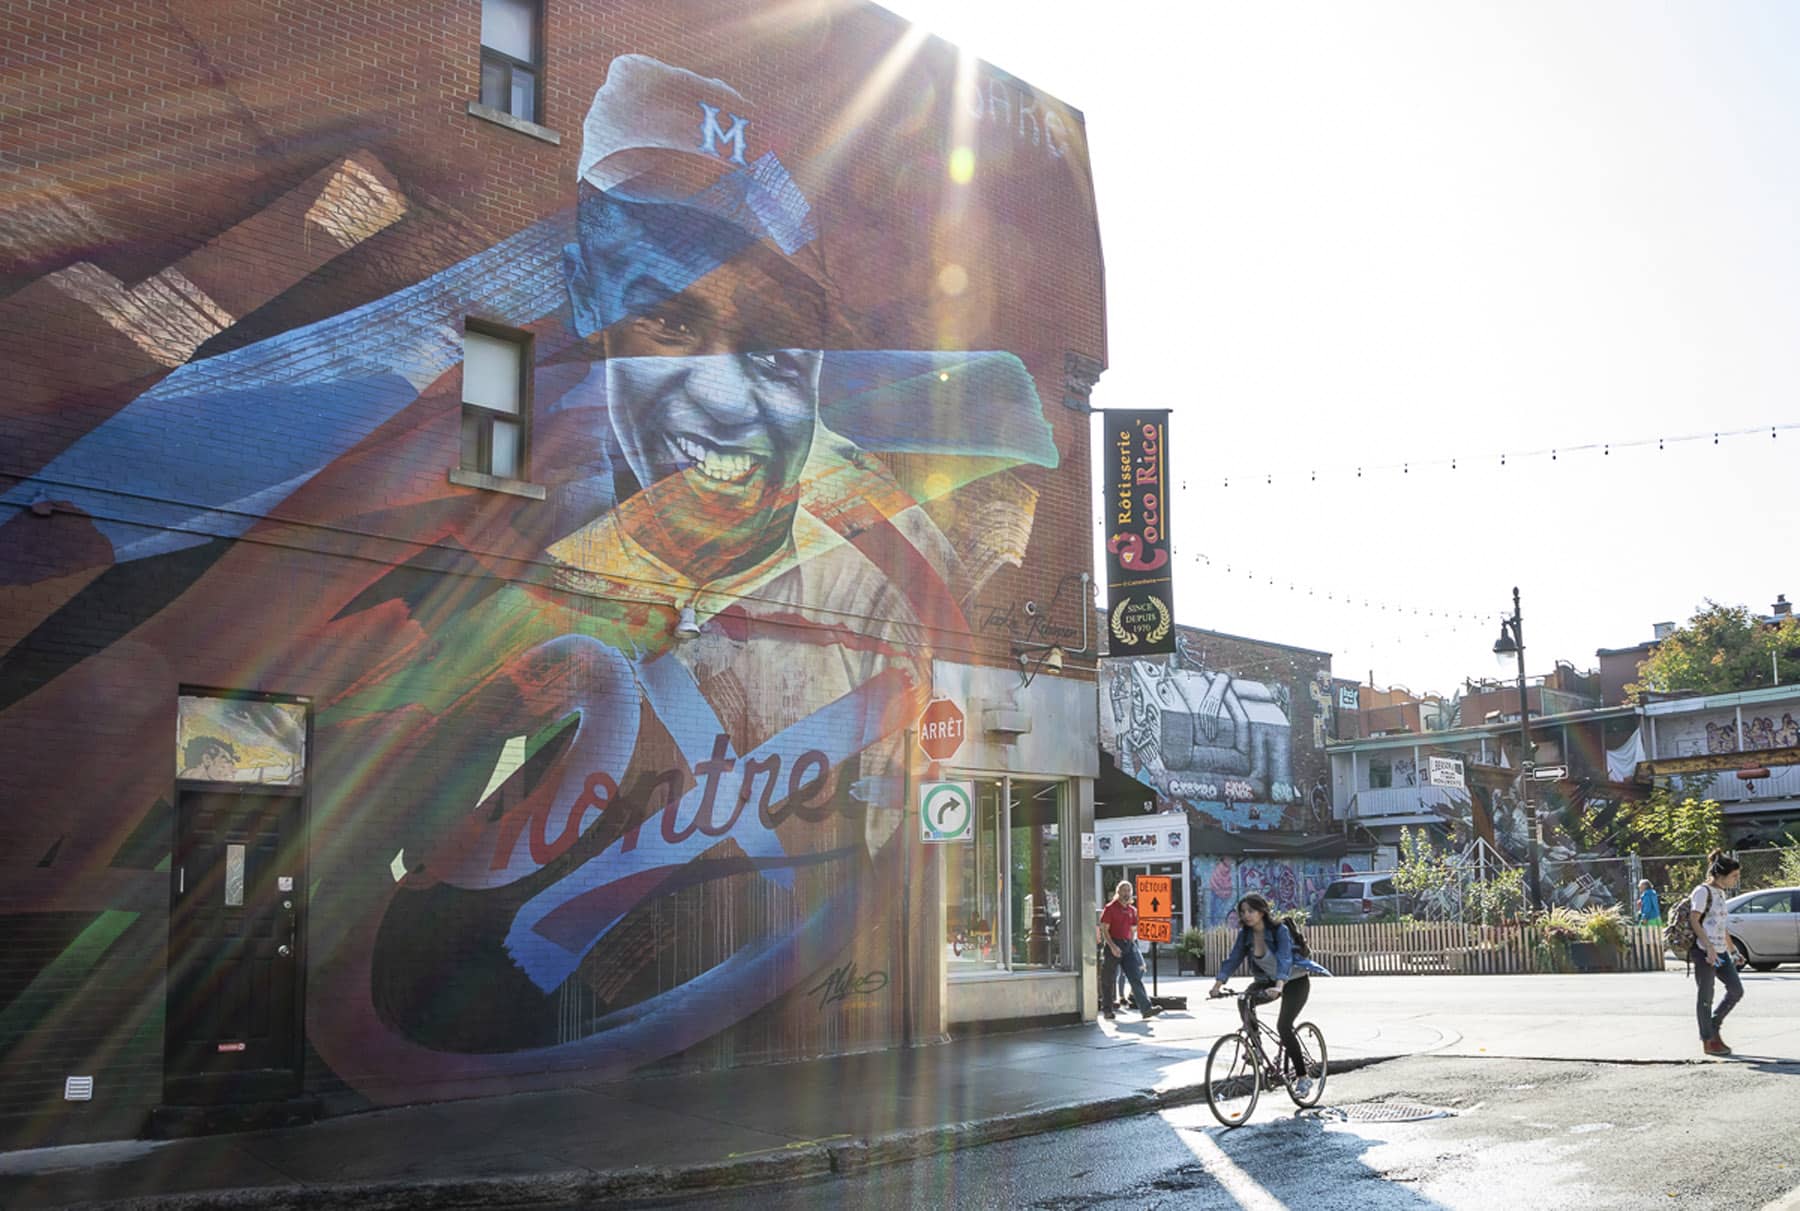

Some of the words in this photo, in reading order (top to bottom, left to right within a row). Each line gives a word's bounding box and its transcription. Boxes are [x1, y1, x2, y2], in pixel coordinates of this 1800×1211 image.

[697, 99, 750, 168] M
[1136, 423, 1158, 485] Rico
[1117, 430, 1132, 525] Rôtisserie
[1127, 602, 1153, 613] SINCE
[1125, 612, 1157, 624] DEPUIS
[1133, 623, 1152, 633] 1970
[920, 717, 963, 740] ARRÊT
[1139, 880, 1168, 893] DÉTOUR
